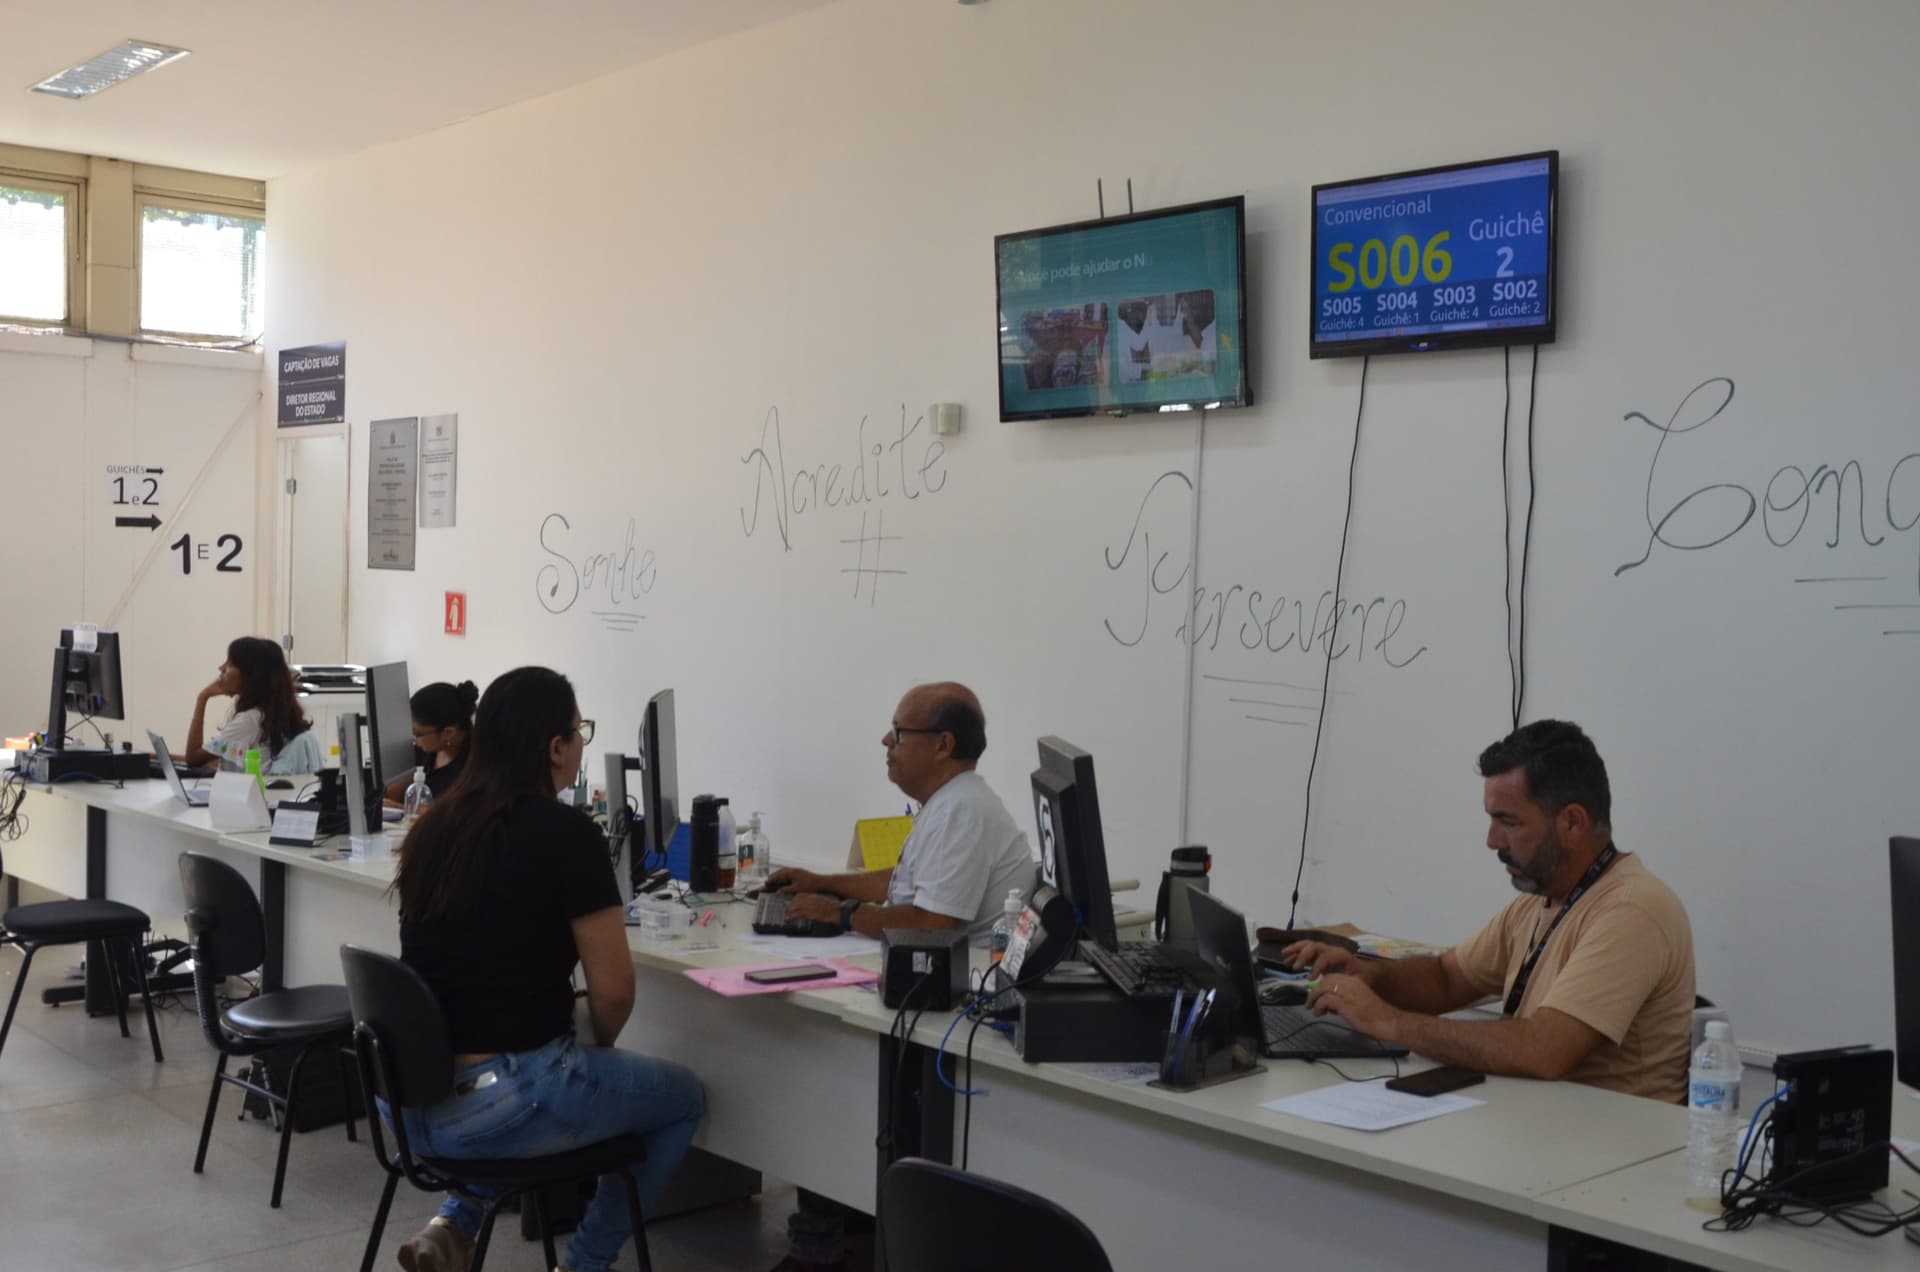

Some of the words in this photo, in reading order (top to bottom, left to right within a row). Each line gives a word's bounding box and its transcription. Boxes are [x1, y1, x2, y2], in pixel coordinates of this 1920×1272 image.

[1325, 193, 1432, 226] Convencional
[1469, 210, 1544, 241] Guichê
[1051, 263, 1080, 283] pode
[1083, 257, 1121, 277] ajudar
[1328, 230, 1452, 293] S006
[1496, 246, 1514, 278] 2
[1323, 296, 1361, 316] S005
[1377, 291, 1418, 312] S004
[1433, 285, 1476, 306] S003
[1493, 279, 1538, 301] S002
[1472, 306, 1479, 318] 4
[1489, 300, 1531, 317] Guichê:
[1534, 301, 1541, 314] 2
[284, 356, 312, 373] CAPTAÇÃO
[313, 357, 320, 369] DE
[320, 355, 339, 368] VAGAS
[286, 392, 308, 406] DIRETOR
[309, 389, 336, 403] REGIONAL
[295, 405, 304, 417] DO
[304, 403, 326, 416] ESTADO
[536, 513, 656, 614] Sonhe
[1104, 471, 1427, 668] Persevere
